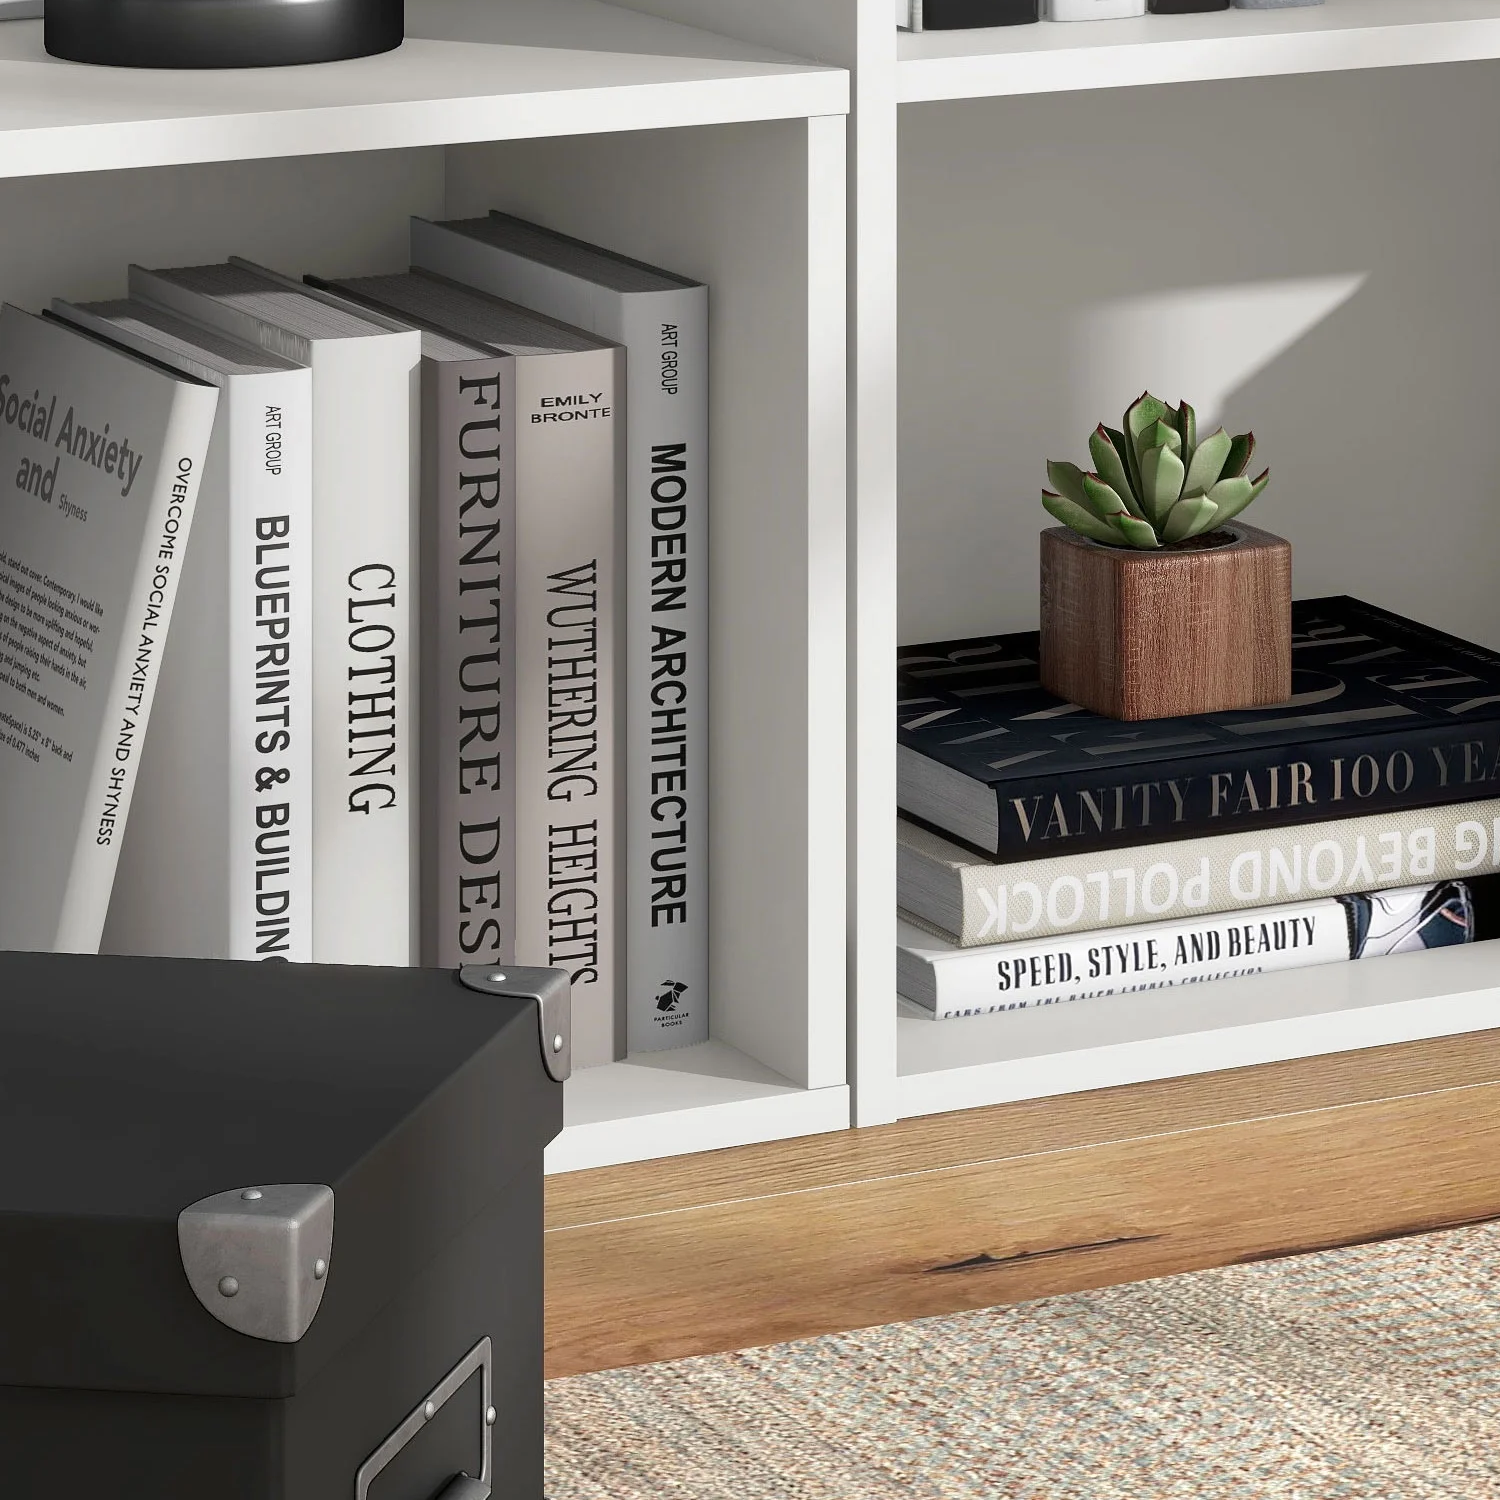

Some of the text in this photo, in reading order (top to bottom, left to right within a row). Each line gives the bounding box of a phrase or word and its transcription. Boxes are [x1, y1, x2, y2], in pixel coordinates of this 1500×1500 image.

[660, 323, 678, 396] ART GROUP
[0, 374, 143, 497] Social Anxiety
[531, 407, 610, 423] BRONTE
[541, 393, 603, 407] EMILY
[265, 405, 281, 476] ART GROUP
[16, 456, 87, 522] and Shyness
[97, 457, 192, 846] OVERCOME SOCIAL ANXIETY AND SHYNESS
[255, 515, 290, 754] BLUEPRINTS
[459, 372, 500, 969] FURNITURE DES
[348, 563, 397, 815] CLOTHING
[650, 443, 687, 927] MODERN ARCHITECTURE
[255, 767, 290, 793] &
[546, 559, 597, 985] WUTHERING HEIGHTS
[1008, 777, 1193, 842] VANITY
[1208, 762, 1319, 818] FAIR
[976, 855, 1211, 938] POLLOCK
[1228, 825, 1436, 900] BEYOND
[997, 915, 1317, 991] SPEED, STYLE, AND BEAUTY
[654, 1013, 689, 1022] PARTICULAR
